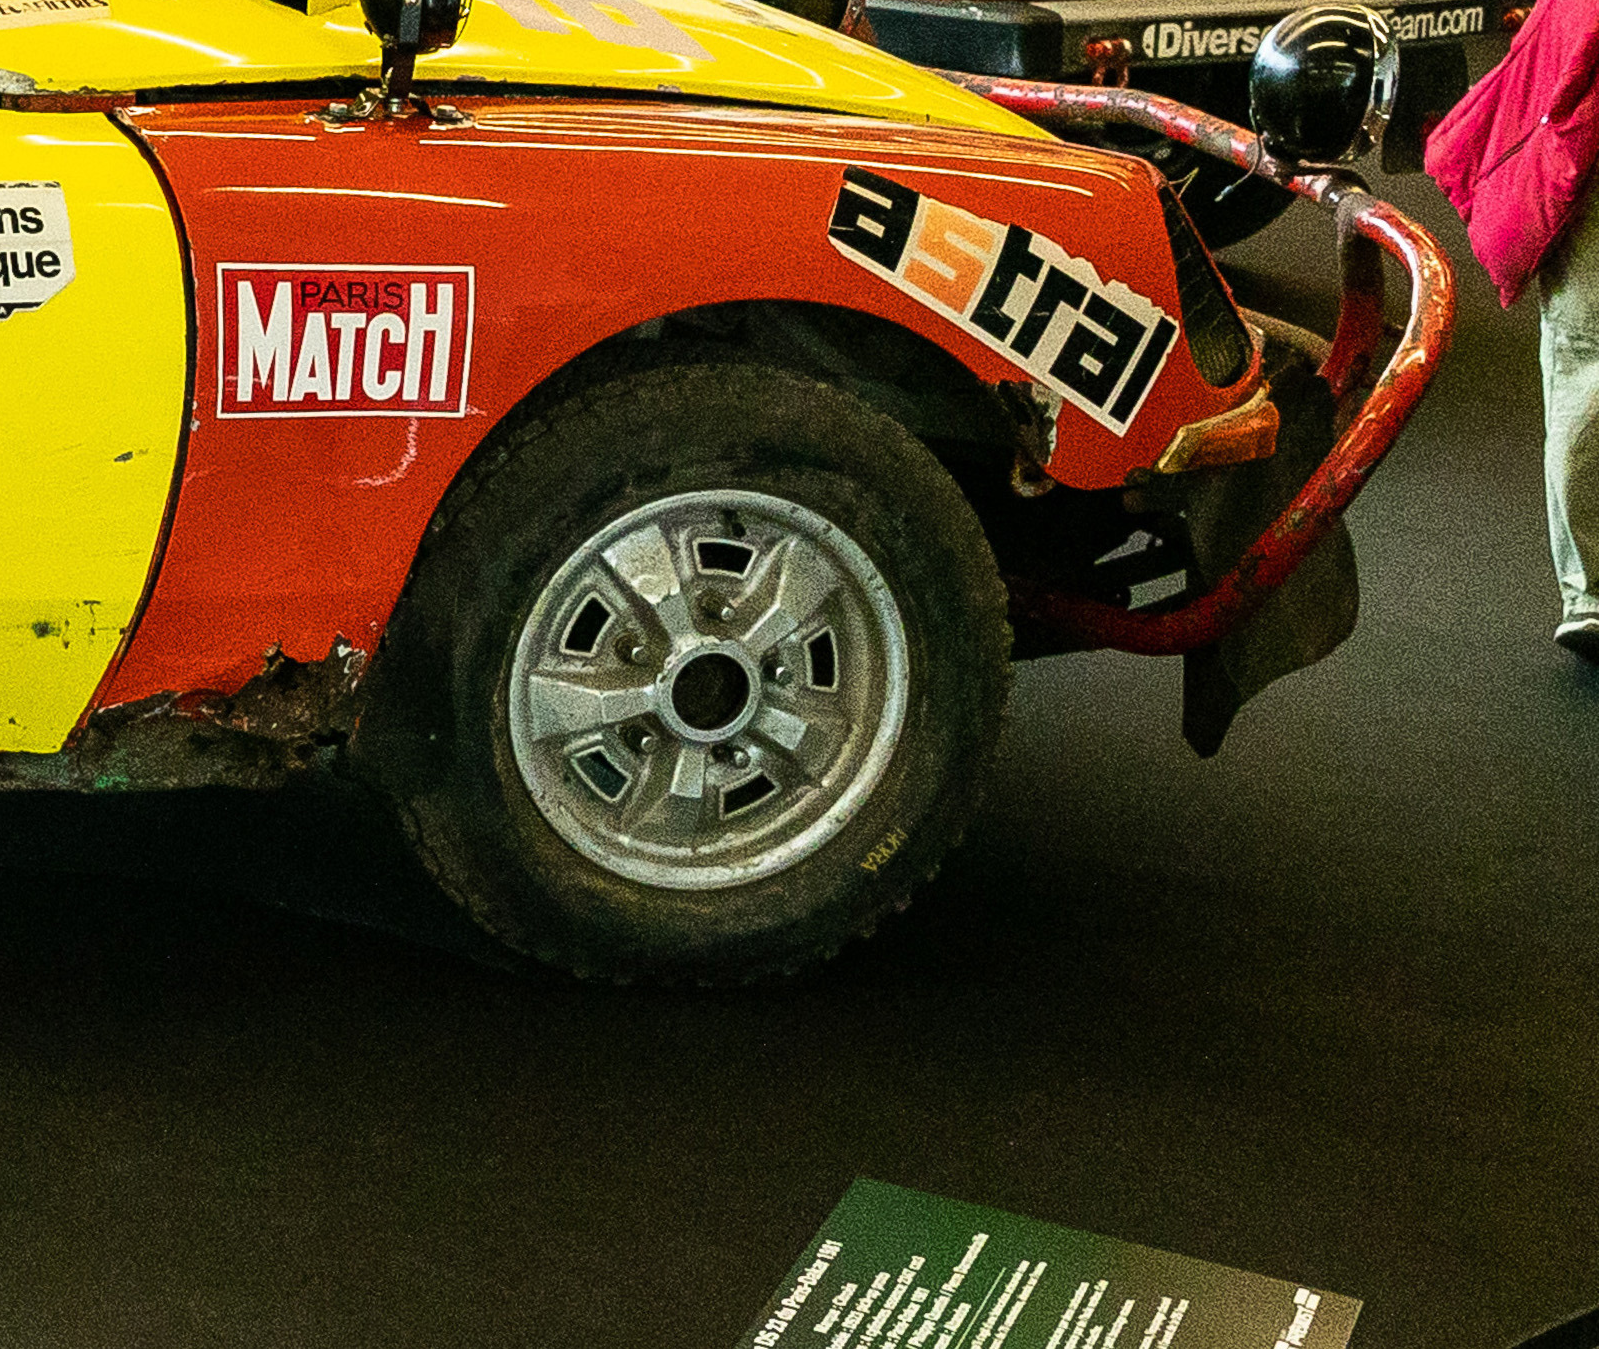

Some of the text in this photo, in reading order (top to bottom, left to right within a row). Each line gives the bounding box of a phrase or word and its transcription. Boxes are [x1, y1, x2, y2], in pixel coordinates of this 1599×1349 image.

[233, 280, 455, 403] MATCH
[298, 280, 404, 311] PARIS
[828, 168, 1178, 425] astral
